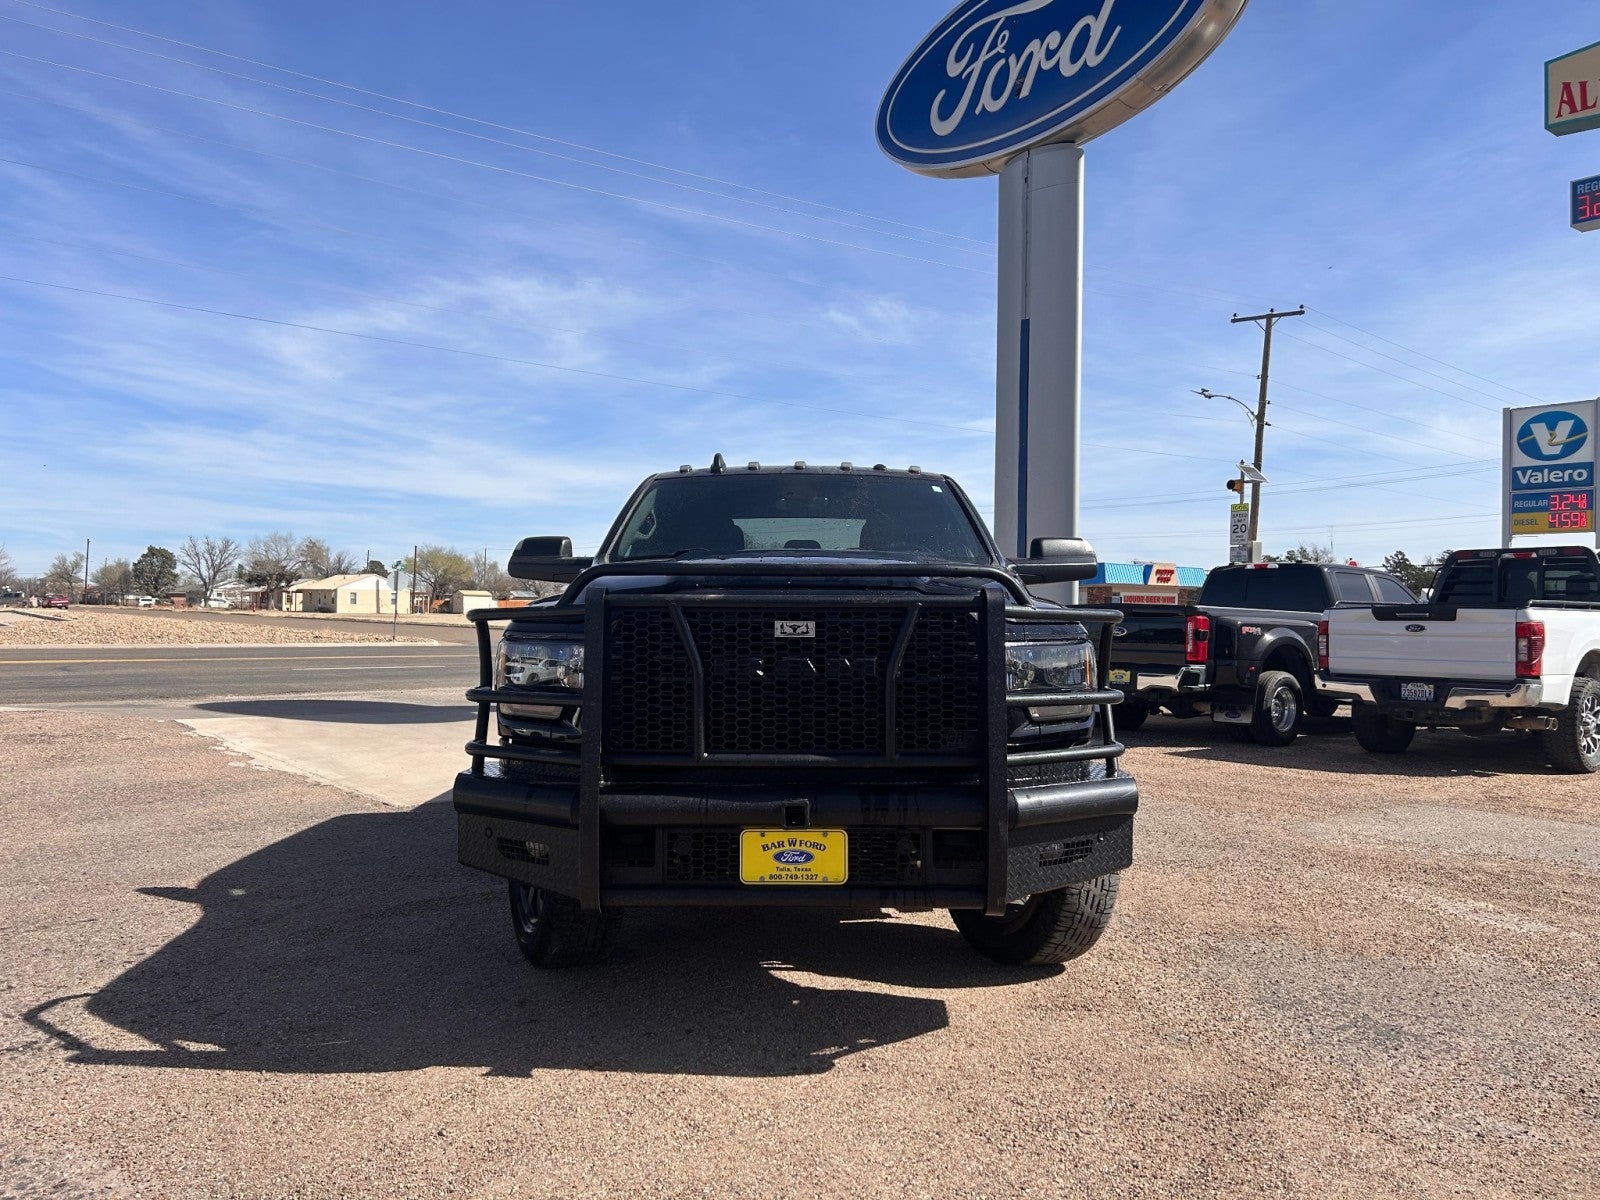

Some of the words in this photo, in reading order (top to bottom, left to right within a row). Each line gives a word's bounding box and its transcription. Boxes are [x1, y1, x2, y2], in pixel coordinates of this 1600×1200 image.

[930, 0, 1121, 136] Ford
[1556, 79, 1600, 118] AL
[1577, 180, 1600, 194] REG
[1516, 468, 1588, 484] Valero
[1514, 499, 1548, 508] REGULAR
[1232, 523, 1247, 534] 20
[761, 840, 786, 852] BAR
[787, 837, 798, 848] W
[798, 839, 827, 852] FORD
[780, 851, 807, 862] Ford
